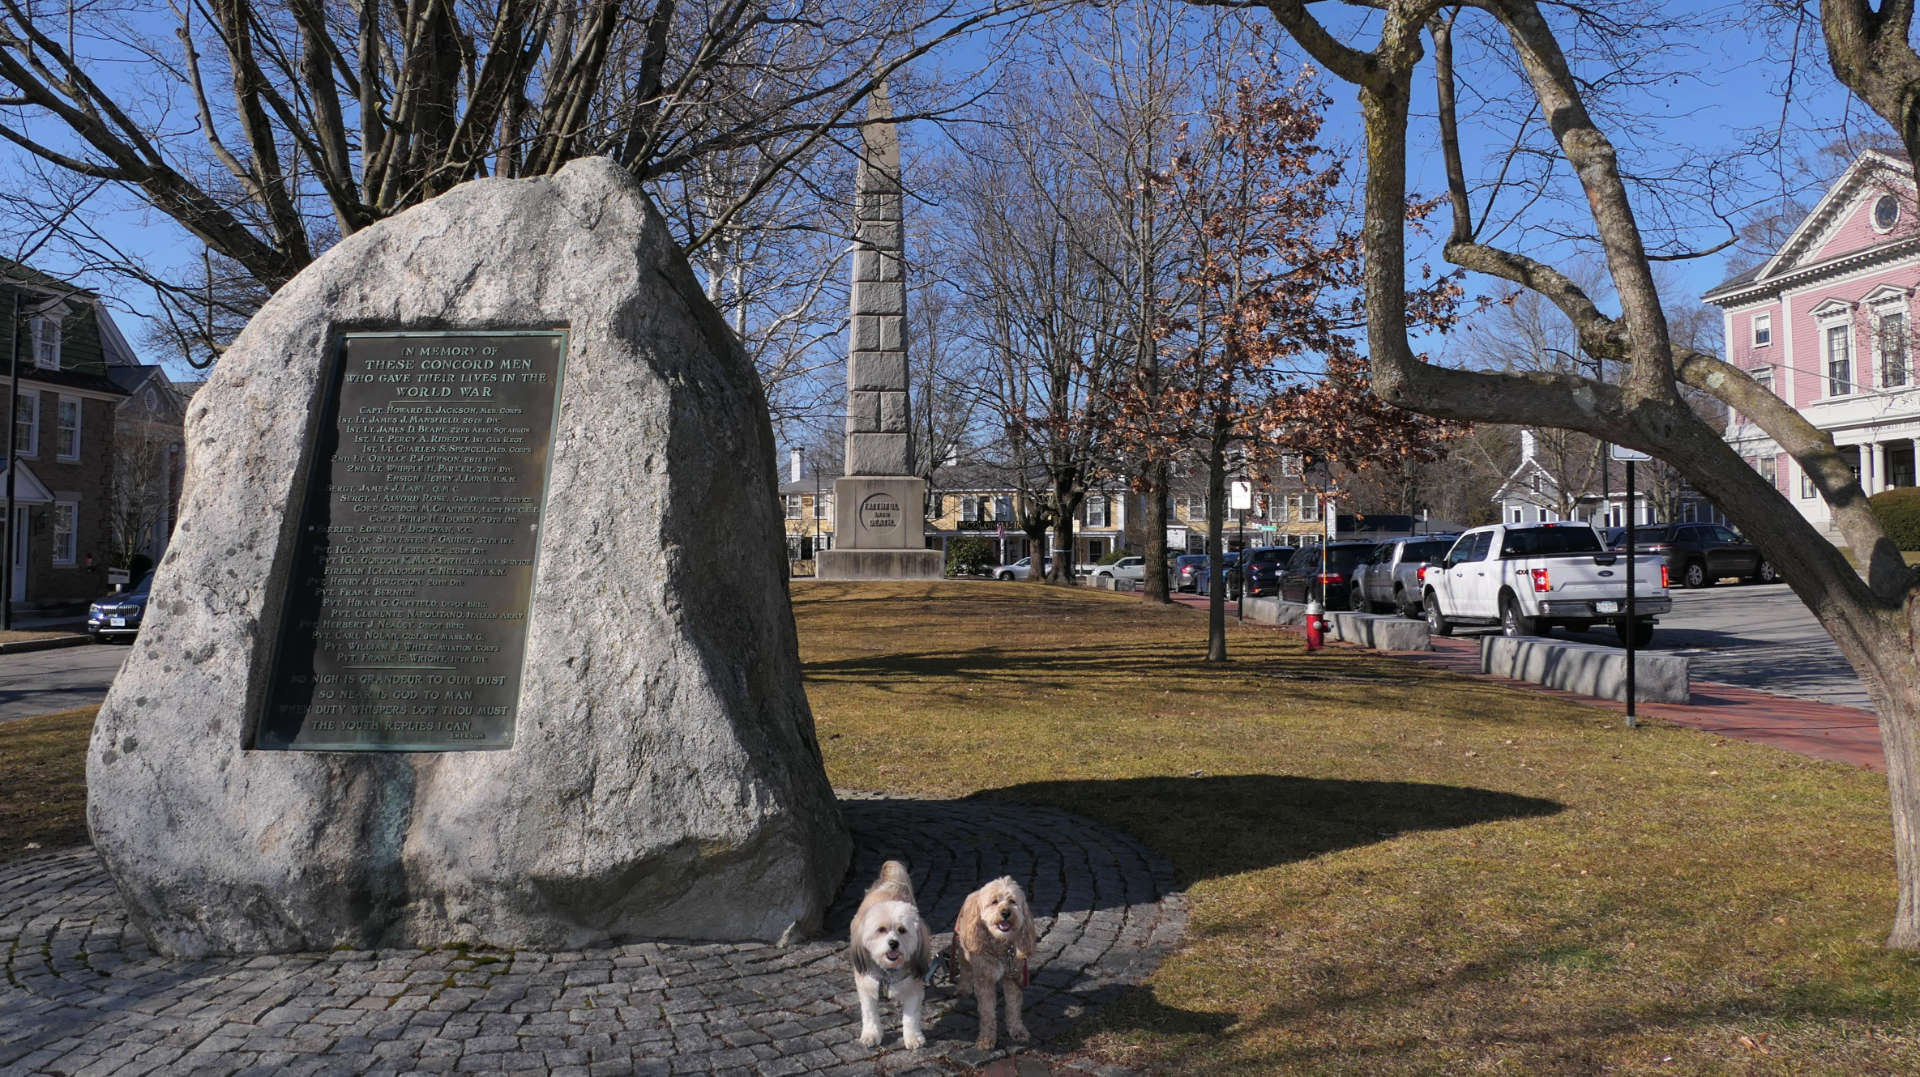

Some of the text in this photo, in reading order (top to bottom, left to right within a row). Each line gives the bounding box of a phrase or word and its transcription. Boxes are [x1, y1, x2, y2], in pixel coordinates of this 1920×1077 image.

[401, 346, 497, 356] IN MEMORY OF
[365, 359, 532, 370] THESE CONCORD MEN
[345, 373, 547, 383] WHO GAVE THEIR LIVES IN THE
[396, 386, 492, 397] WORLD WAR
[386, 406, 422, 414] HOWARD
[369, 415, 398, 424] JAMES
[377, 425, 404, 433] JAMES
[387, 435, 418, 443] PERCY
[395, 445, 436, 453] CHARLES
[330, 577, 360, 585] HENRY
[339, 588, 372, 596] FRANK
[355, 609, 403, 618] CLEMENTE
[426, 673, 443, 684] TO
[447, 675, 472, 684] OUR
[477, 675, 505, 685] DUST
[319, 690, 335, 699] SO
[392, 690, 418, 699] GOD
[424, 690, 440, 699] TO
[444, 690, 473, 699] MAN
[315, 705, 346, 714] DUTY
[441, 706, 473, 715] THOU
[478, 706, 508, 715] MUST
[311, 721, 336, 730] THE
[341, 721, 378, 730] YOUTH
[384, 721, 434, 730] REPLIES
[446, 721, 472, 730] CAN
